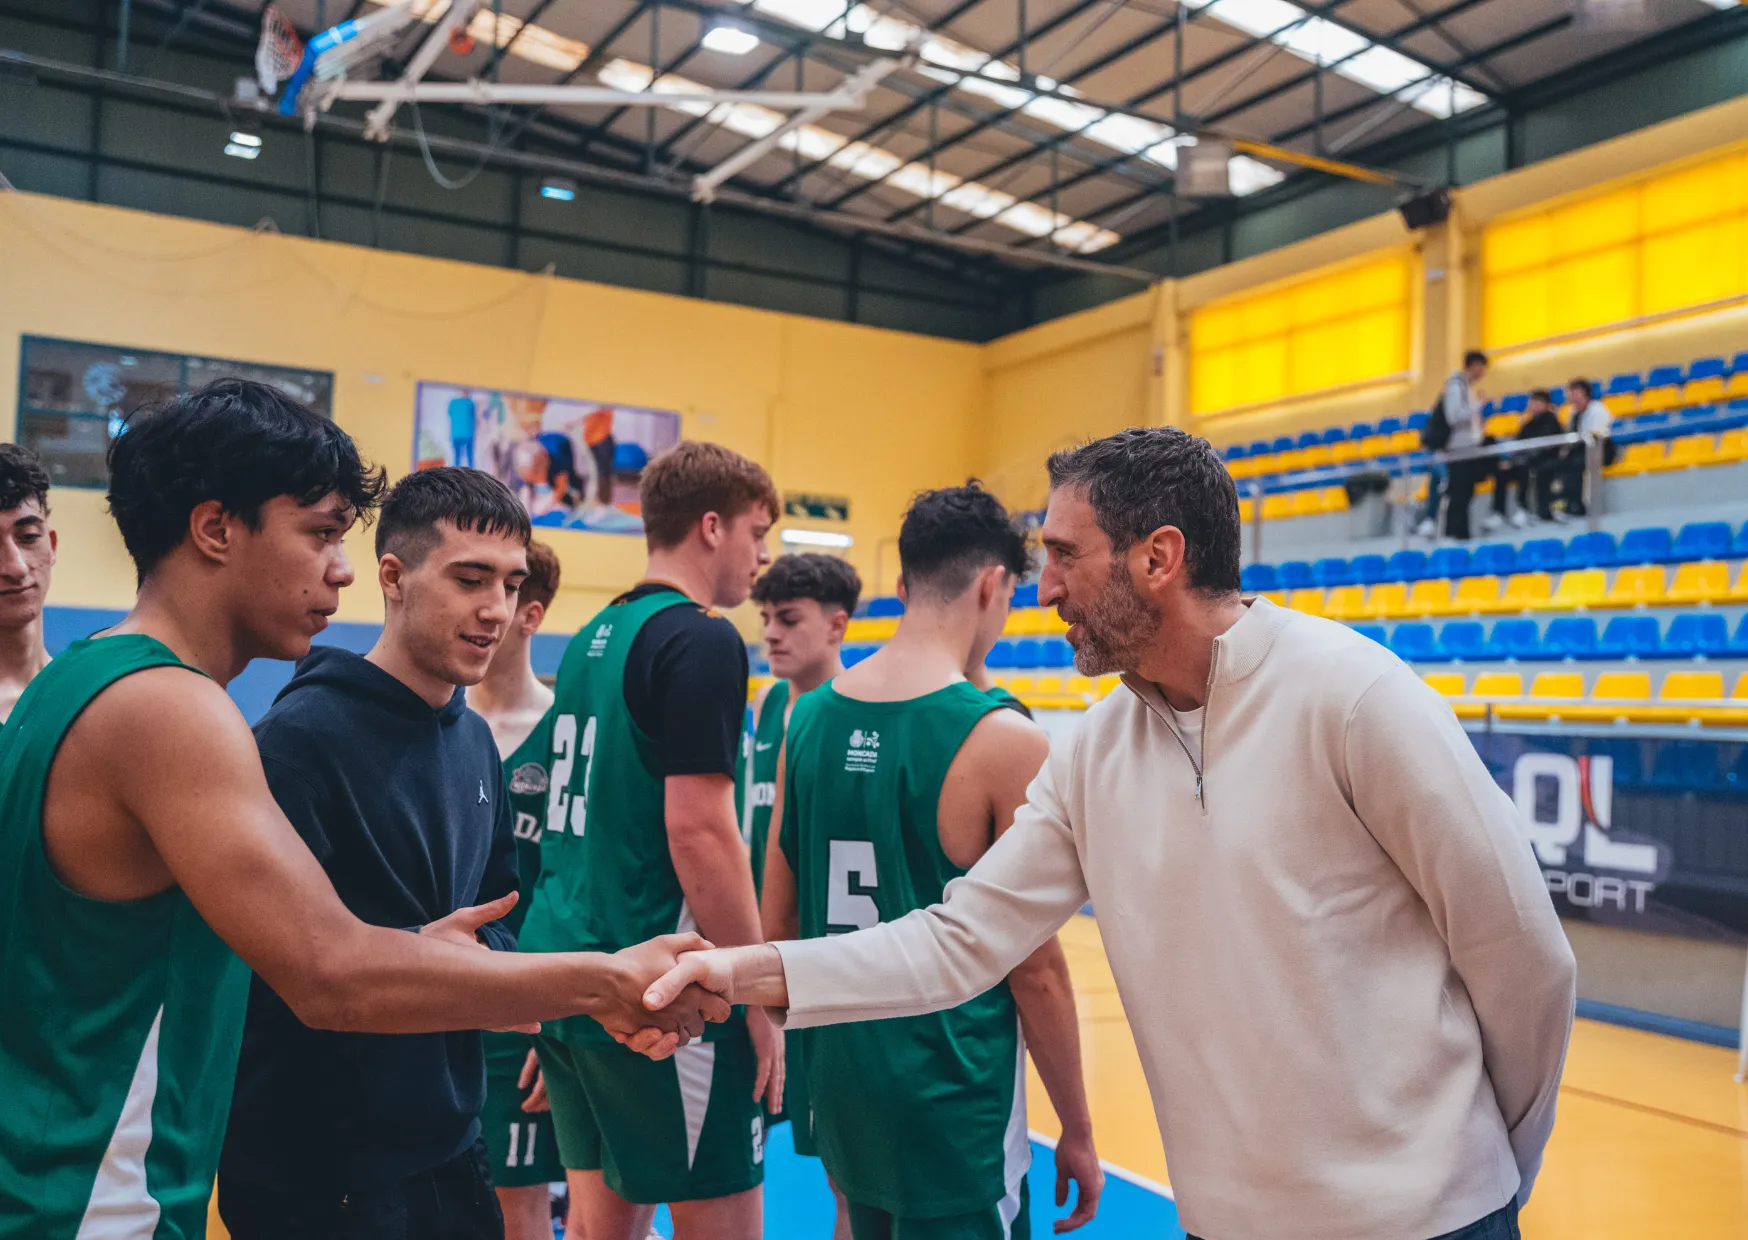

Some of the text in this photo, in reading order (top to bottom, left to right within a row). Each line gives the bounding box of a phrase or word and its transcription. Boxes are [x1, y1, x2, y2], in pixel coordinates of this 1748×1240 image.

[1513, 752, 1658, 874] QL
[826, 839, 880, 937] 5
[1544, 869, 1656, 913] PORT
[506, 1122, 537, 1167] 11
